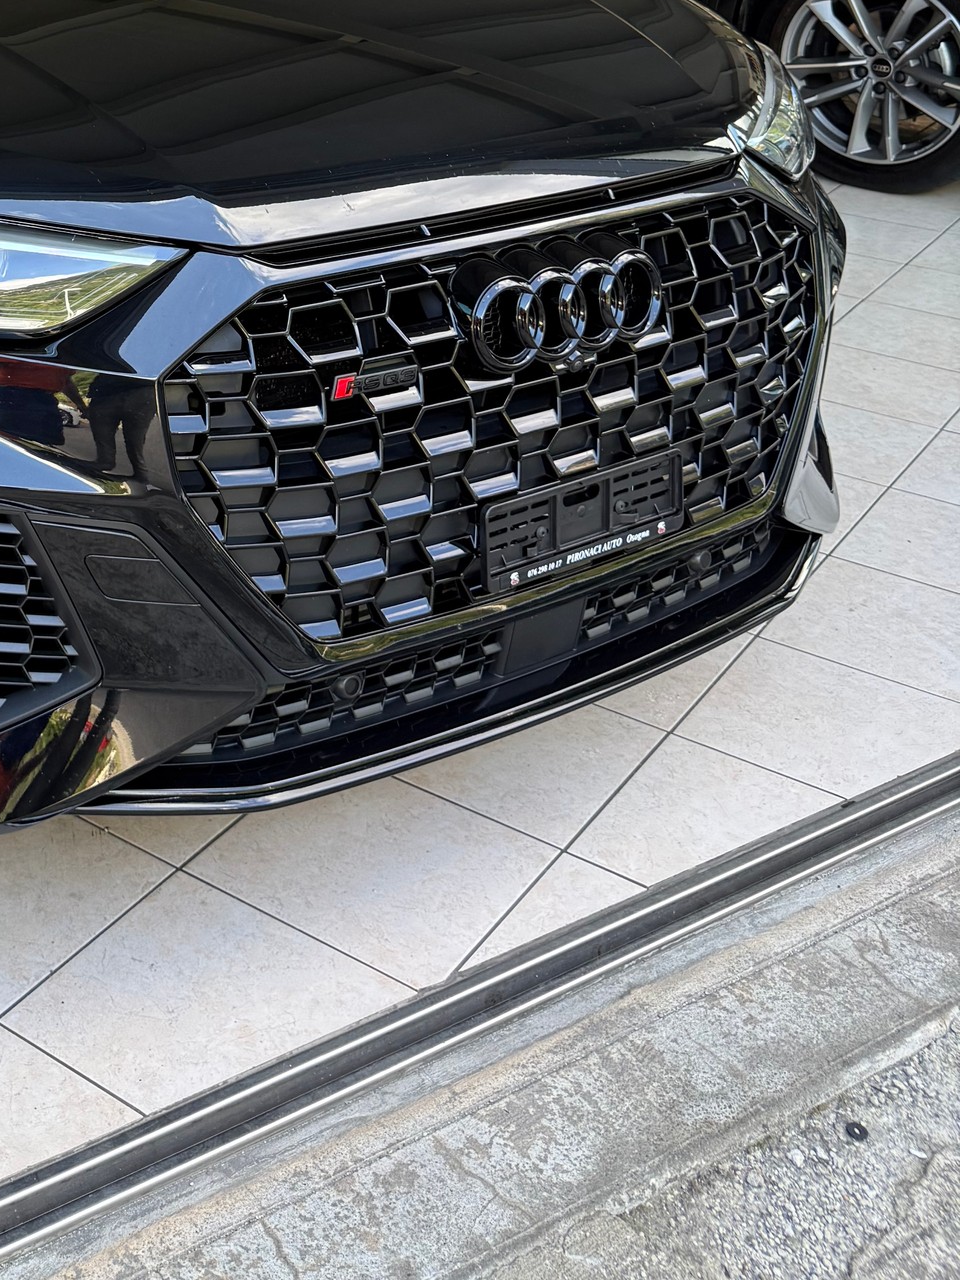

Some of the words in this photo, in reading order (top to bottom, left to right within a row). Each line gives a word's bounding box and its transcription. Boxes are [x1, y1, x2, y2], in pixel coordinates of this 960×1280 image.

[566, 546, 602, 565] PIRONACI
[602, 537, 622, 552] AUTO
[626, 529, 650, 543] Osogna
